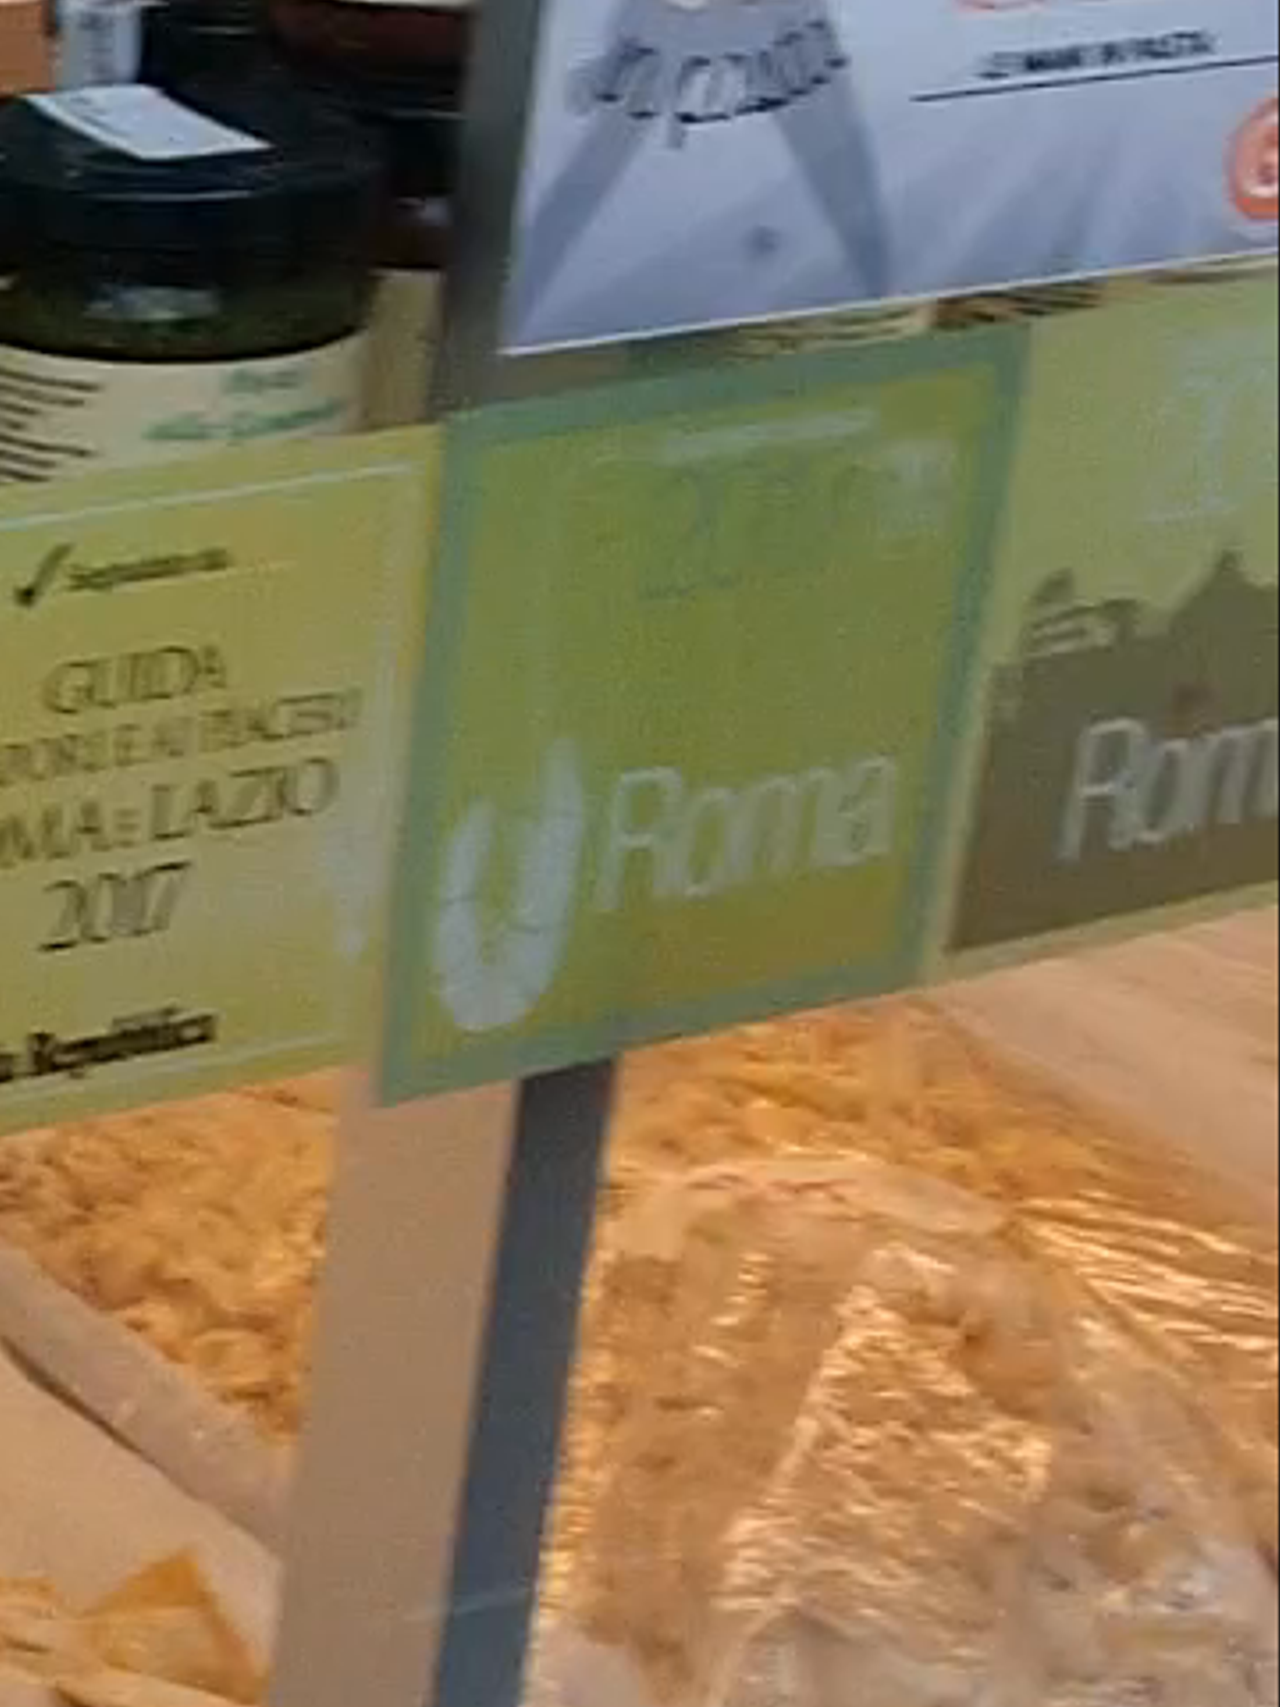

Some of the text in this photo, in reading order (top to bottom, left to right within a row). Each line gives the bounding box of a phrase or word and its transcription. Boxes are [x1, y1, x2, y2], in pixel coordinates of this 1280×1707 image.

[41, 643, 229, 716] GUIDA
[147, 756, 342, 841] LAZIO
[593, 753, 900, 913] Roma
[37, 860, 193, 953] 2017
